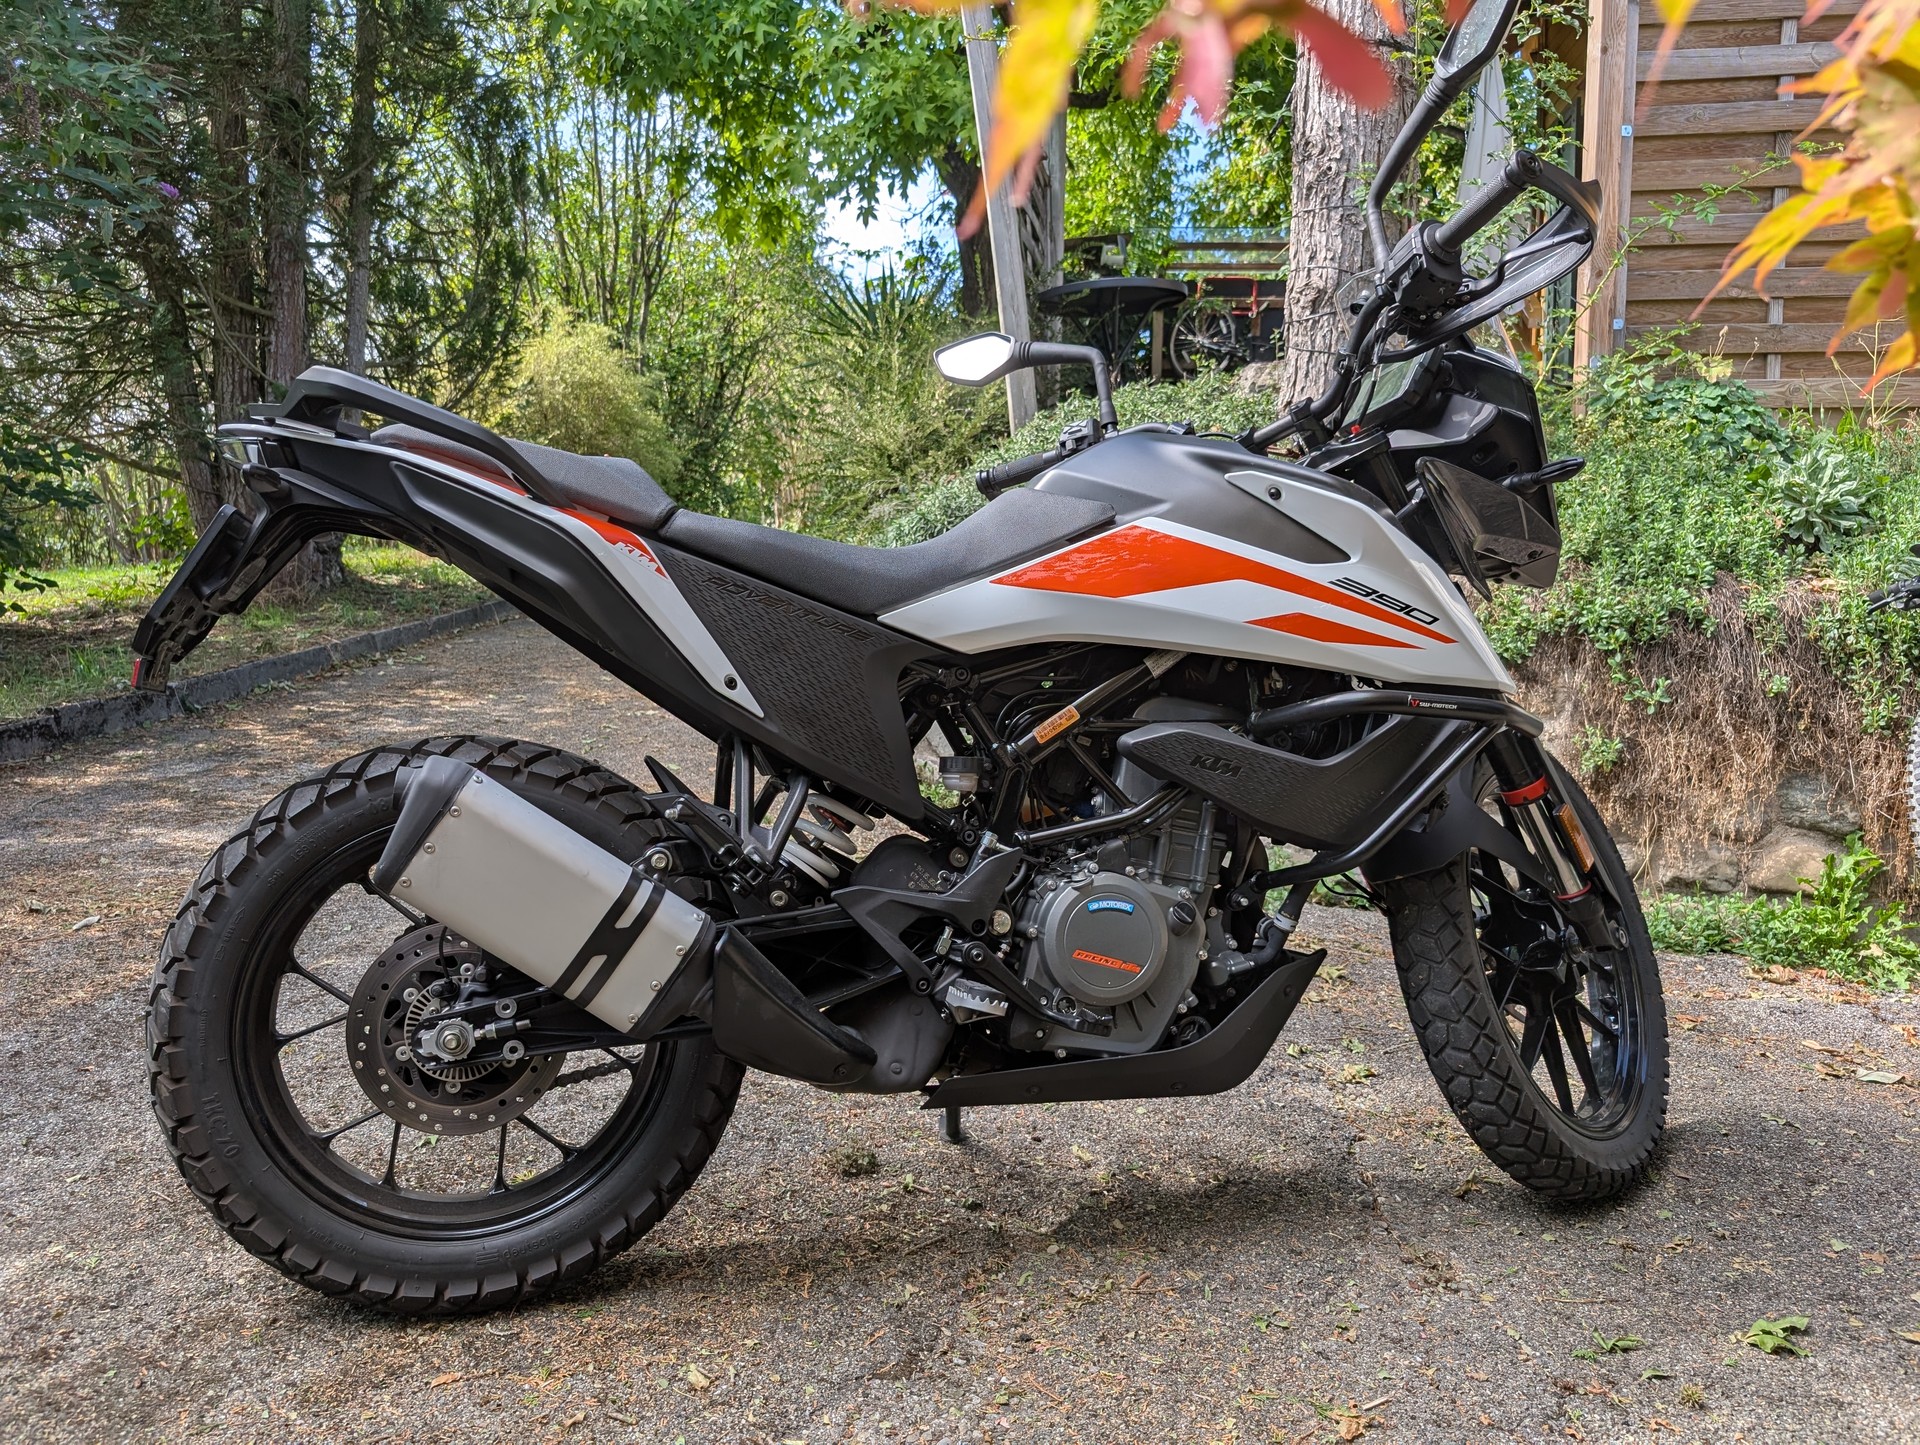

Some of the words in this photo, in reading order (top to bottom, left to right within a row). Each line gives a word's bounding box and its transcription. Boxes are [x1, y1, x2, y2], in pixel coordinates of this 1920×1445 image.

[614, 542, 659, 575] KTM
[702, 575, 875, 643] ADVENTURE
[1327, 577, 1440, 627] 390
[1419, 701, 1458, 711] SW-MOTECH
[1189, 754, 1243, 779] KTM
[1098, 900, 1130, 910] MOTOREX
[1075, 951, 1119, 967] RACING
[201, 1092, 228, 1129] TKC
[216, 1132, 241, 1159] 70
